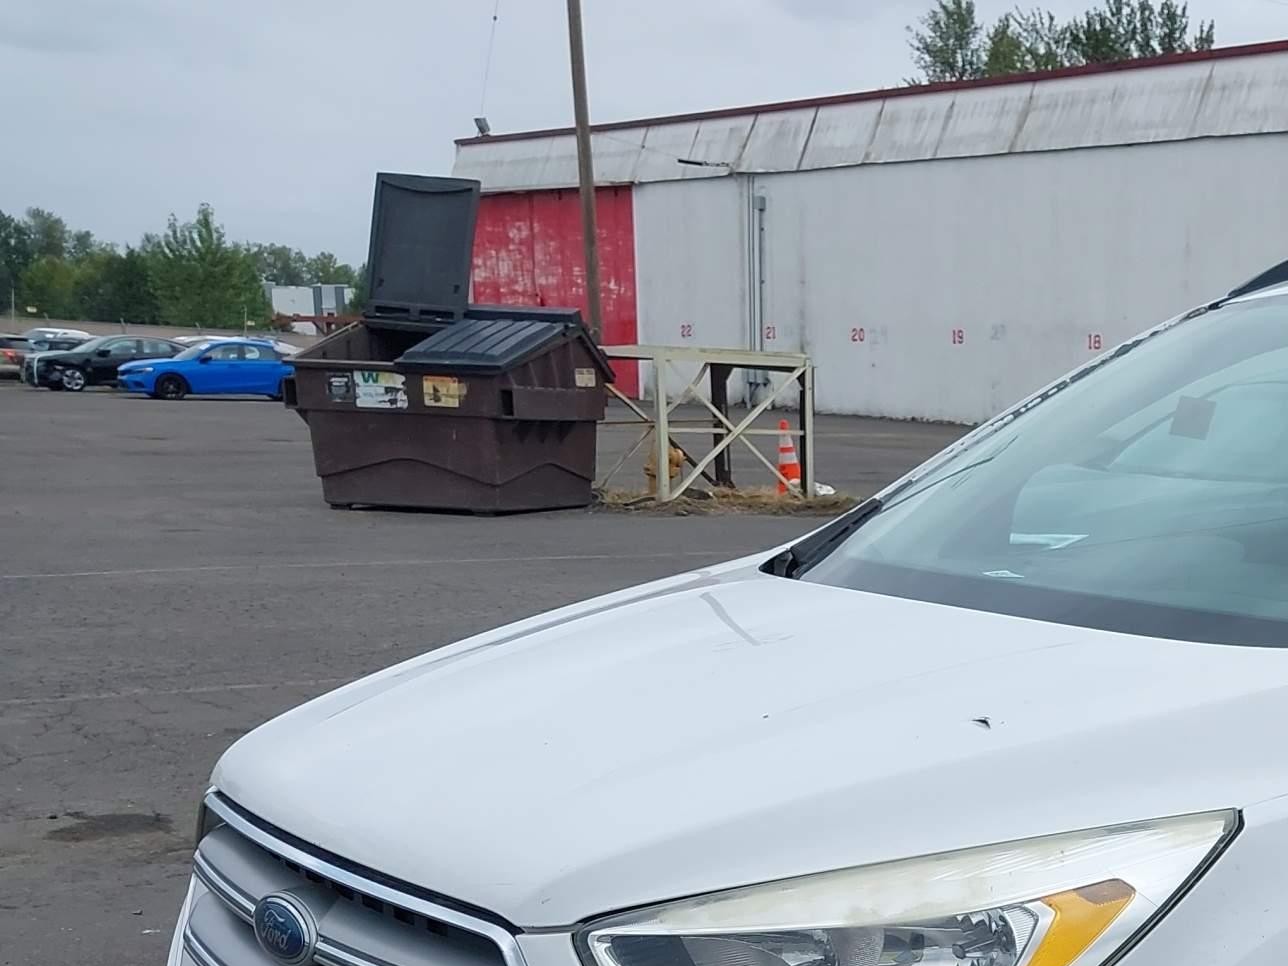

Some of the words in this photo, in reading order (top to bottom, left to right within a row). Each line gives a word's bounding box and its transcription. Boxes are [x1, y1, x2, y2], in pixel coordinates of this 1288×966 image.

[680, 324, 692, 338] 22
[766, 326, 776, 340] 21
[851, 328, 865, 342] 20
[952, 329, 964, 345] 19
[1088, 333, 1101, 350] 18
